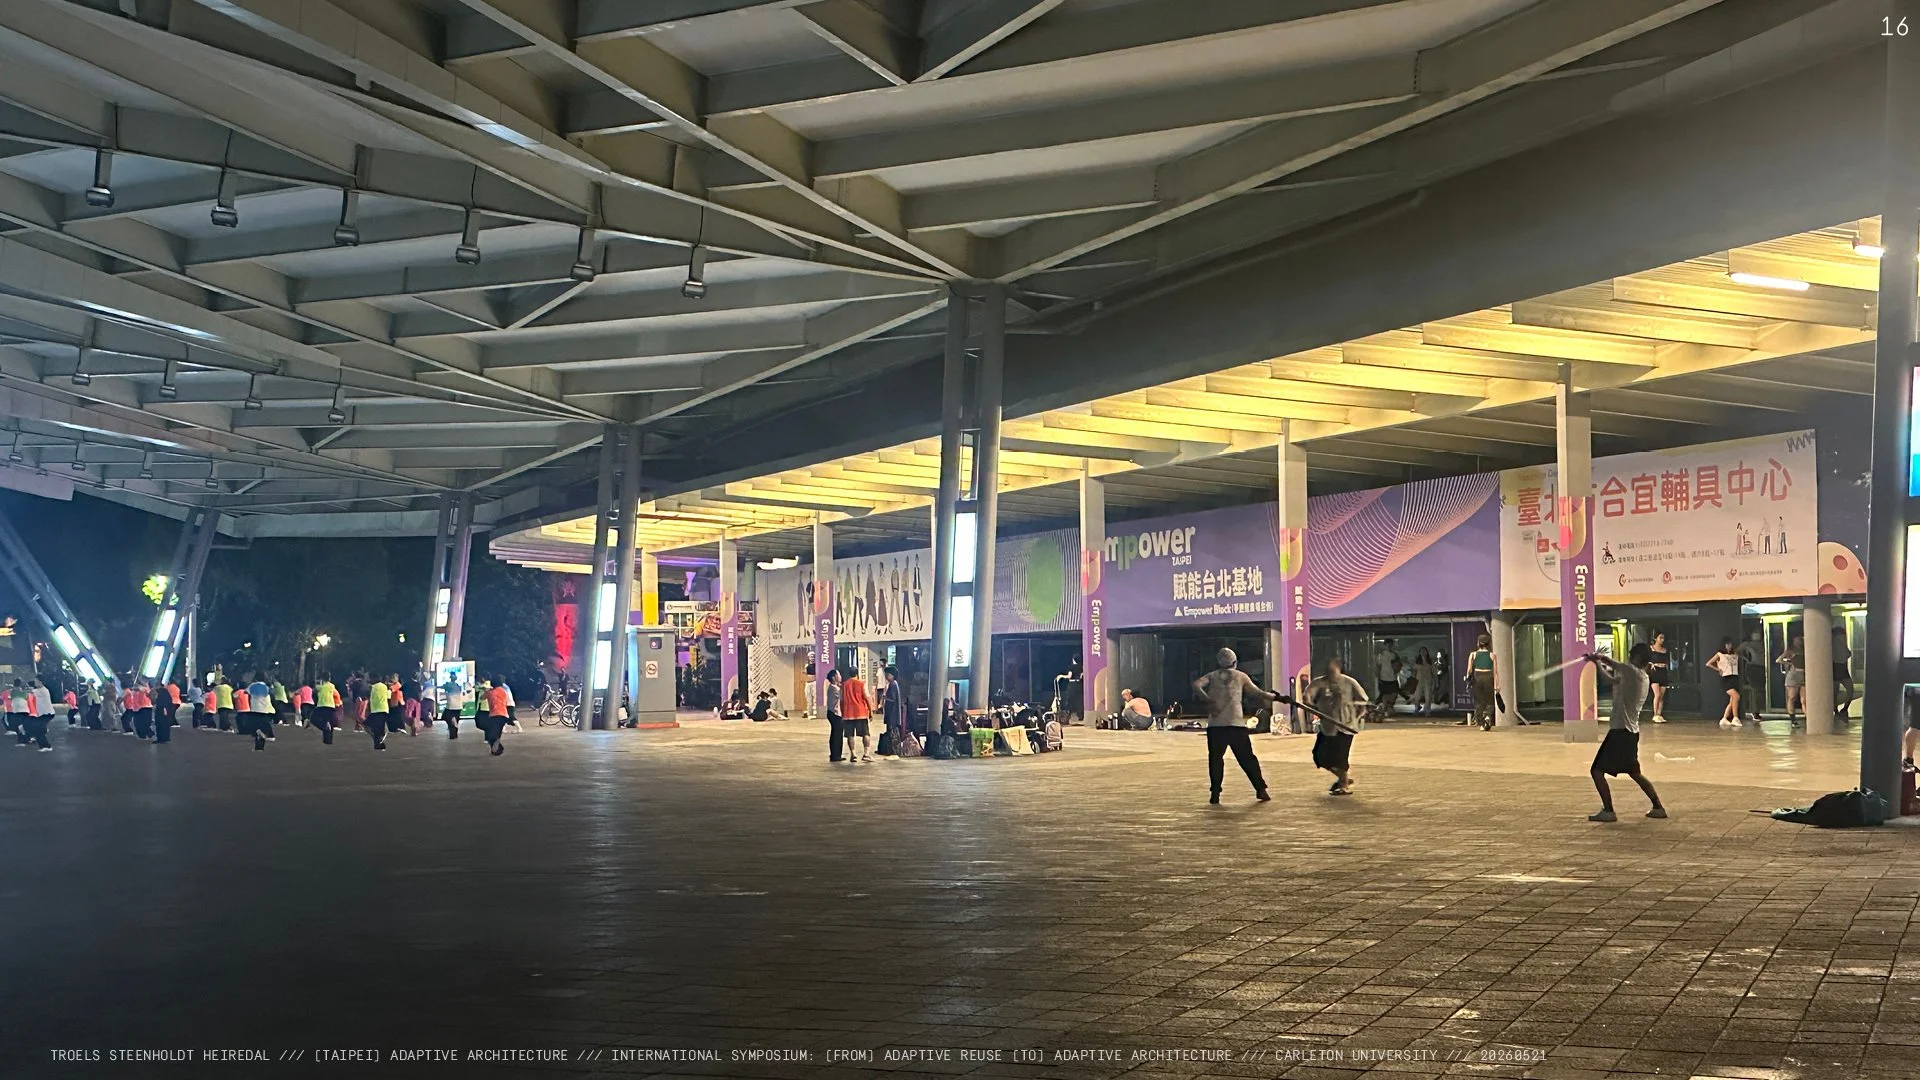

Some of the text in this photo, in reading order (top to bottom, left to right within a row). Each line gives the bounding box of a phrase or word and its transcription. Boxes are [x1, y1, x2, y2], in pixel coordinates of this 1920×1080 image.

[1105, 526, 1196, 570] mpower
[1173, 565, 1263, 600] 賦能台北基地
[1574, 564, 1589, 646] Empower
[1091, 599, 1103, 657] Empower
[1184, 606, 1212, 618] Empower
[820, 618, 832, 665] Empower
